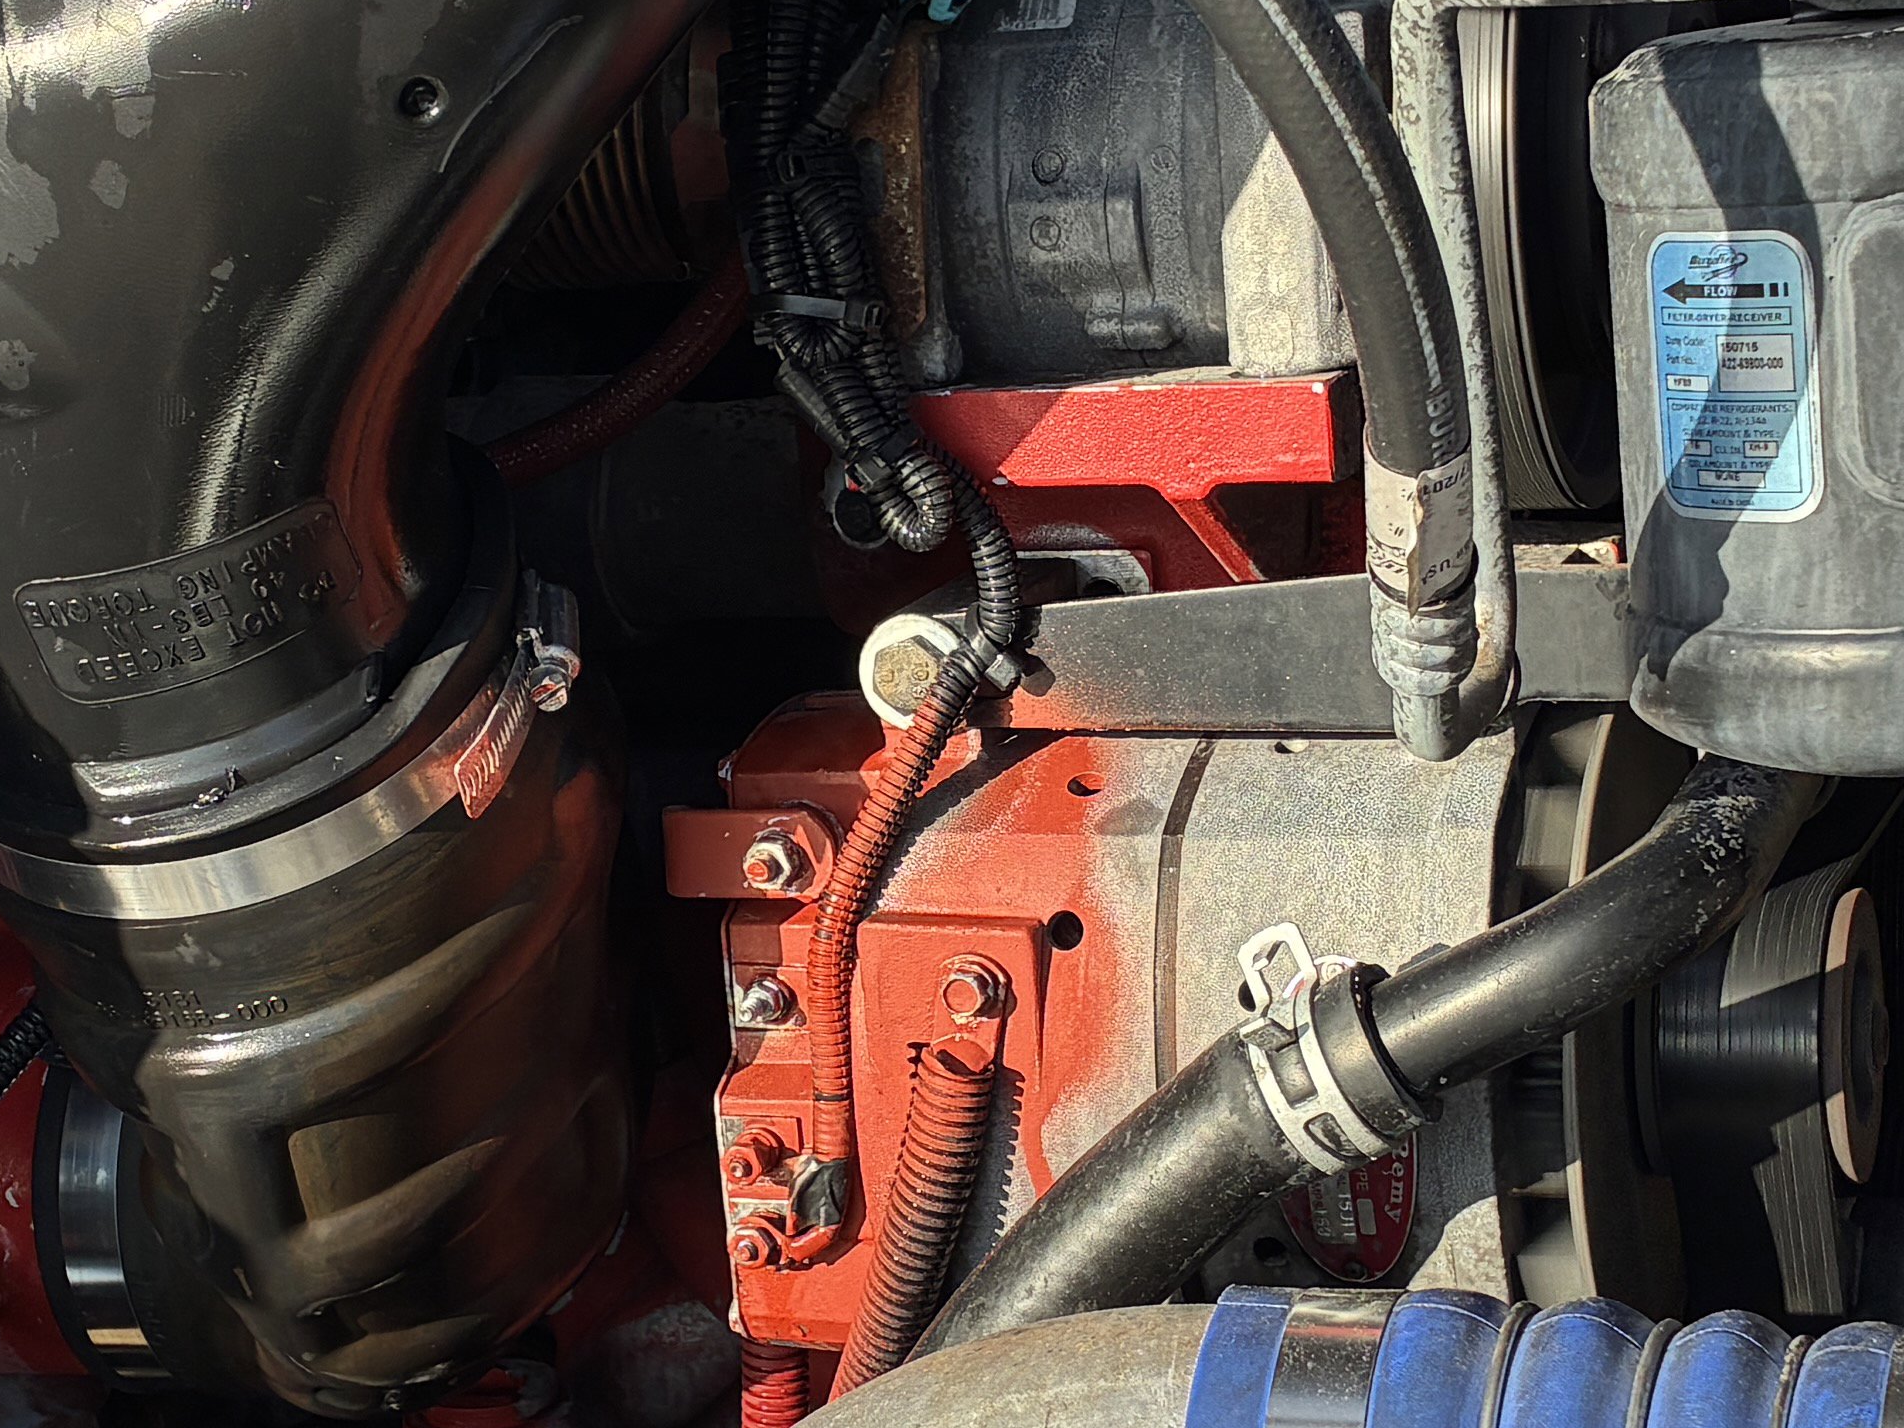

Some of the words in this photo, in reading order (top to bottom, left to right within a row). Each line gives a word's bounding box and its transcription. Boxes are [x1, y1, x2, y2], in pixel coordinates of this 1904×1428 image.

[1703, 285, 1738, 298] FLOW
[22, 587, 159, 628] TORQUE
[75, 634, 207, 684] EXCEED
